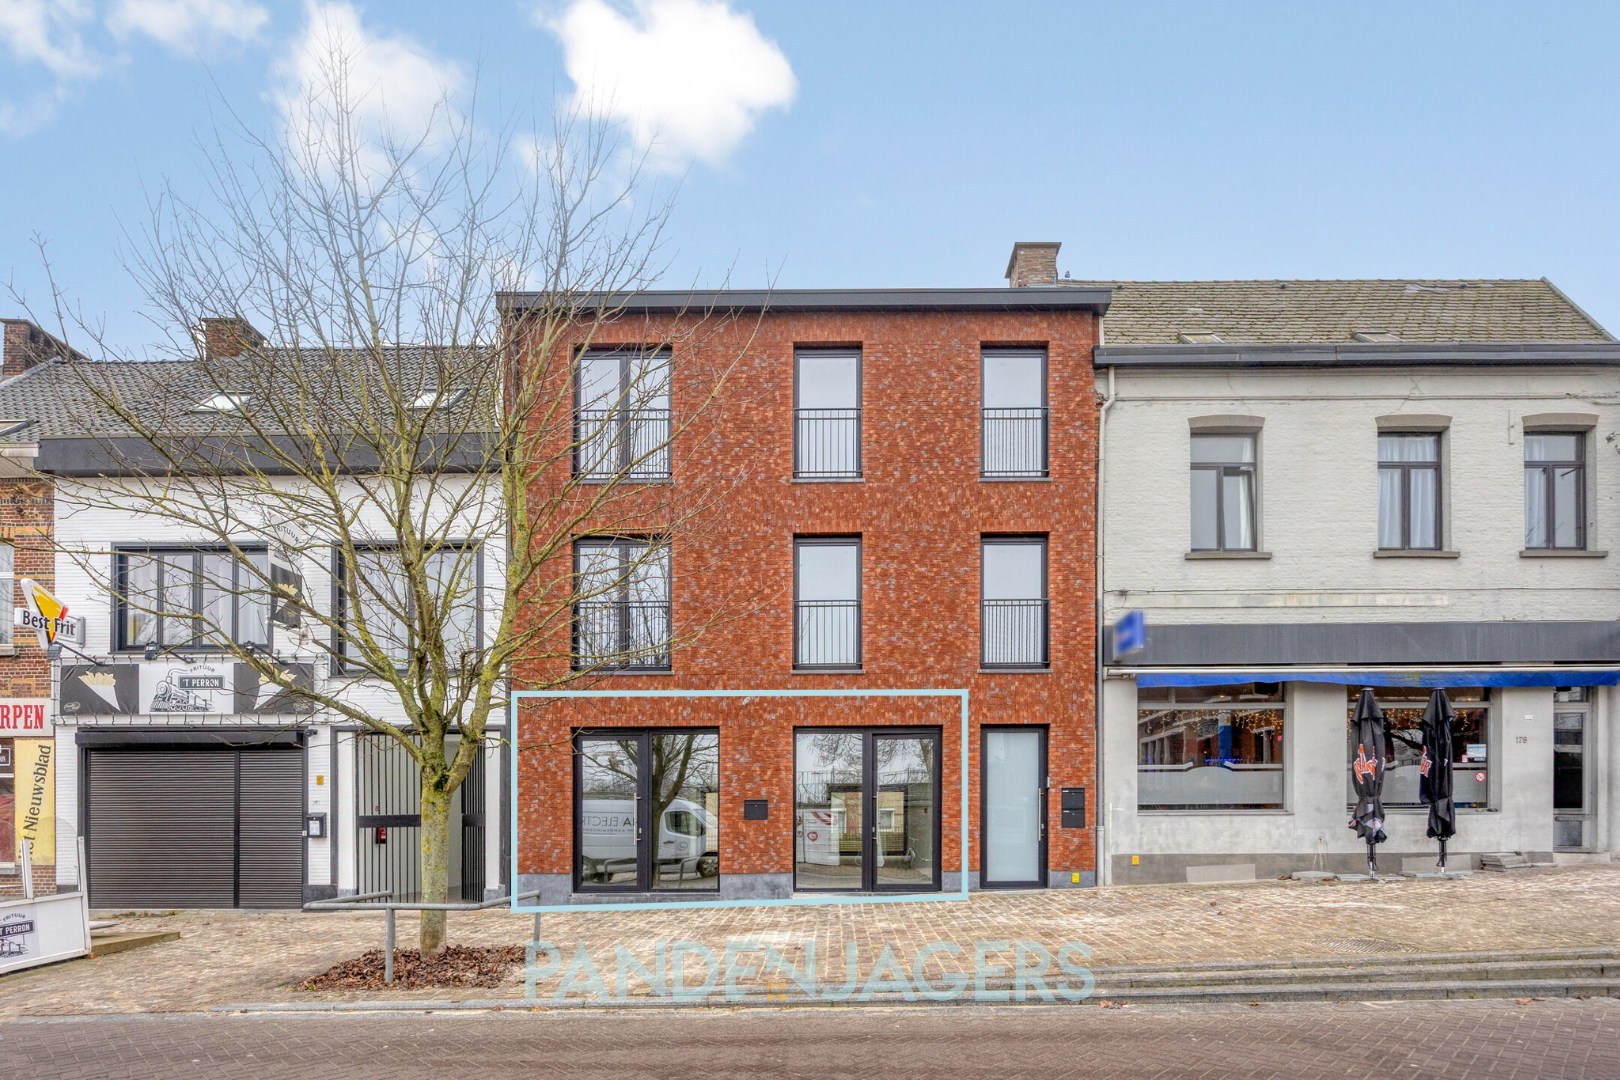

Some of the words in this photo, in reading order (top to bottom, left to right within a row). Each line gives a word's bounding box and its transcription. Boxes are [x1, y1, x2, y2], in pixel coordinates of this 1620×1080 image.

[22, 610, 50, 630] Best
[54, 617, 76, 636] Frit
[189, 665, 216, 673] FRITUUR
[191, 679, 220, 688] PERRON
[23, 745, 51, 832] Nieuwsblad
[5, 923, 31, 935] PERRON
